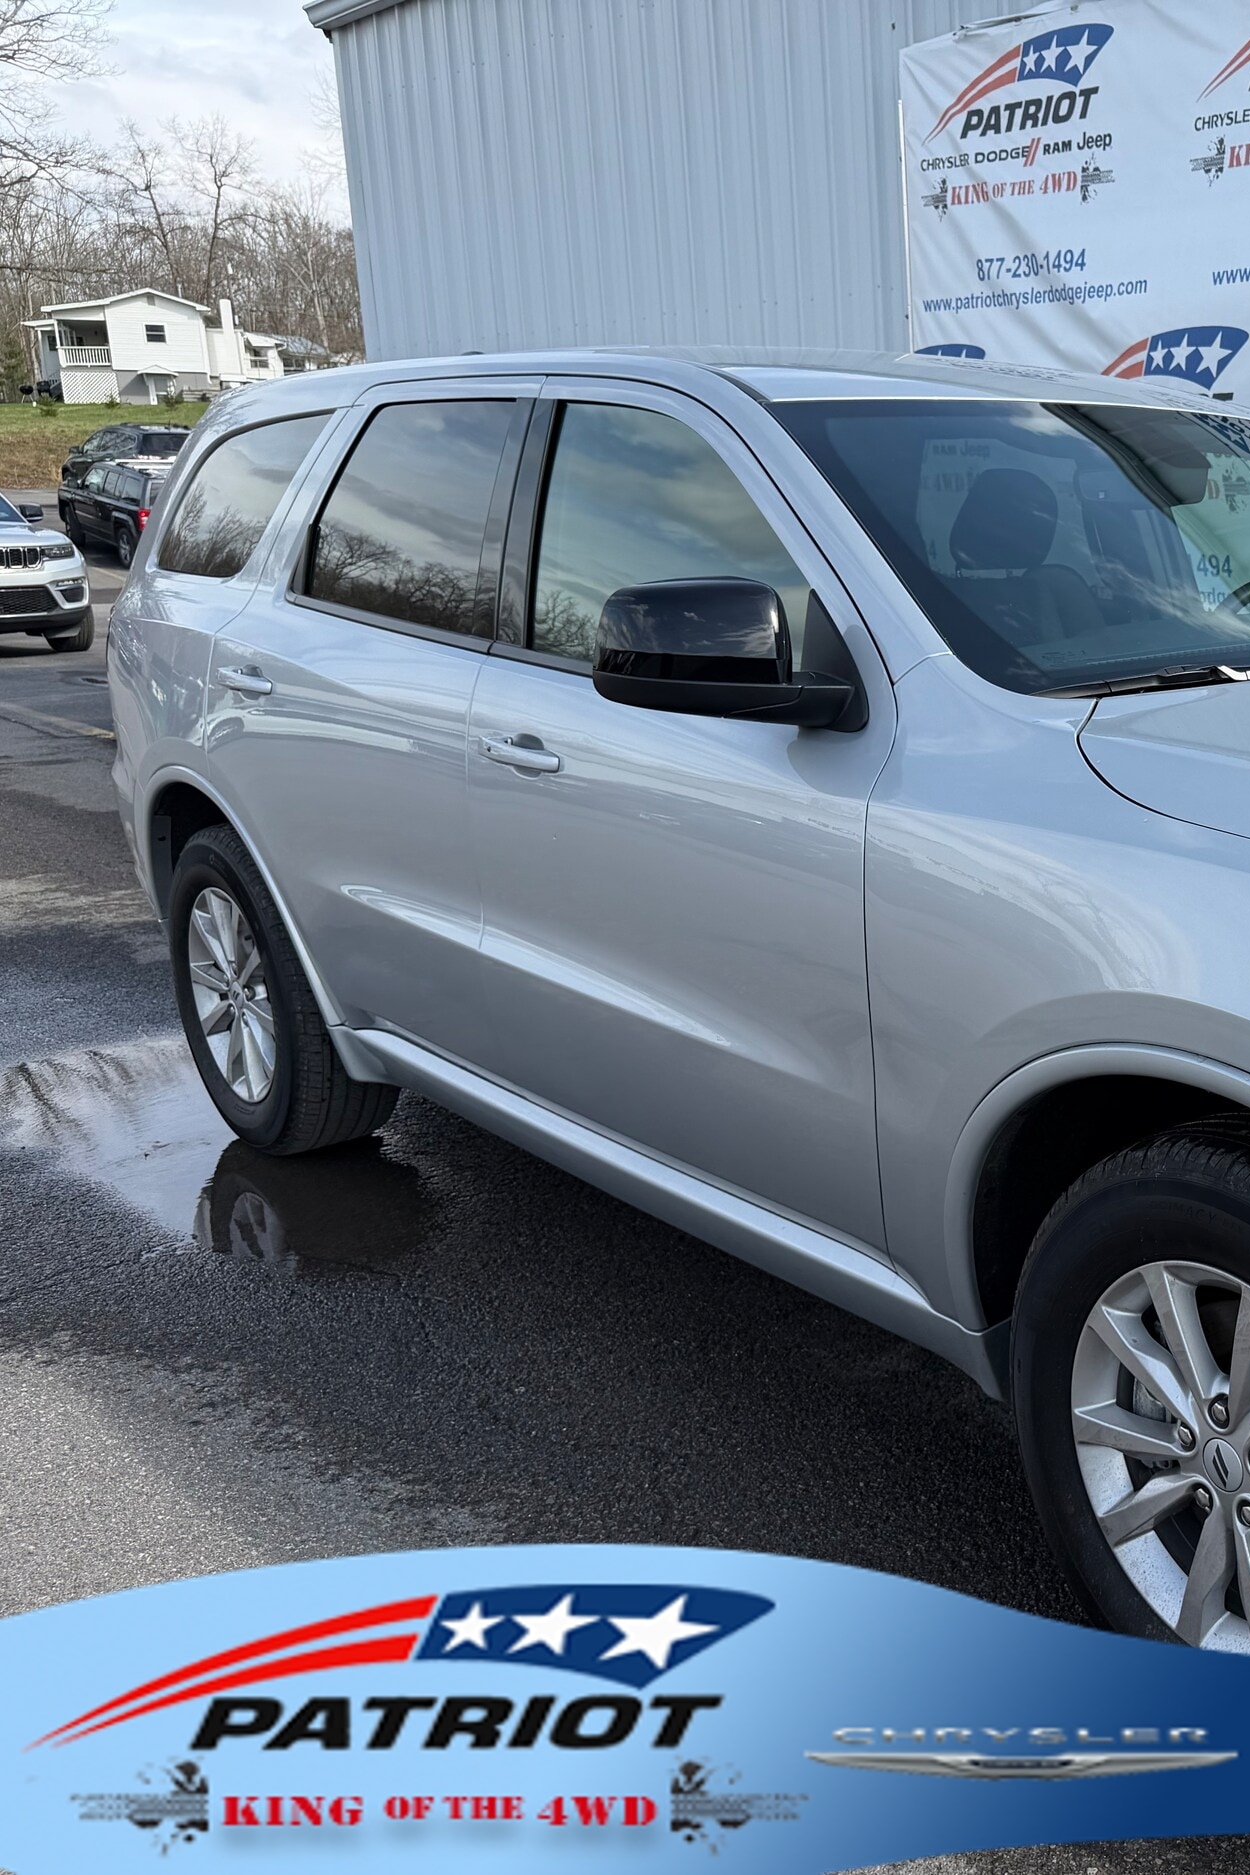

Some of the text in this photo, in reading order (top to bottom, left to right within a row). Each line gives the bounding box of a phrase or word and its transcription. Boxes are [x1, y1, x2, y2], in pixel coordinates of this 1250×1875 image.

[960, 86, 1099, 140] PATRIOT
[920, 131, 1112, 173] CHRYSLER DODGE RAM Jeep
[950, 170, 1078, 207] KING OF THE 4WD
[976, 248, 1086, 282] 877-230-1494
[922, 276, 1149, 314] www.patriotchryslerdodgejeep.com
